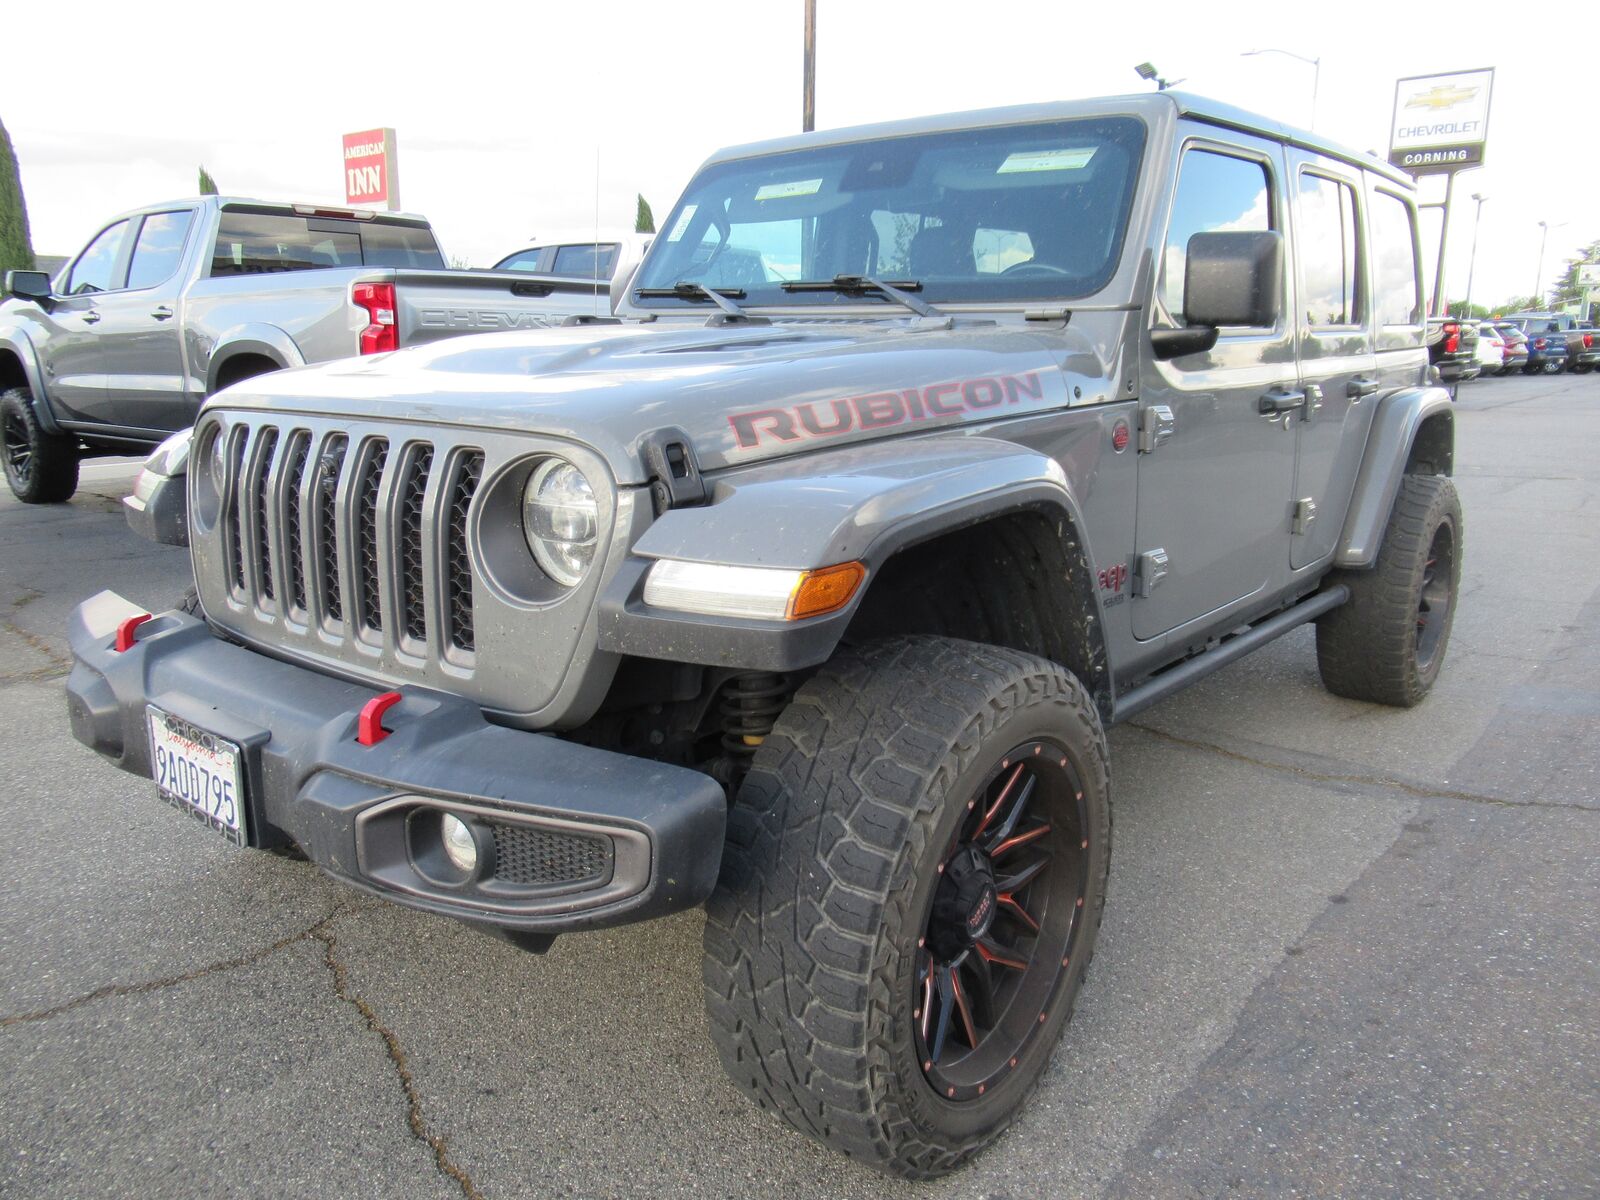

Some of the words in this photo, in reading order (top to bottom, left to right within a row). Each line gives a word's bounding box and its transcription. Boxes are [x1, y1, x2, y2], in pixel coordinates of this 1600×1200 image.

[1398, 120, 1480, 138] CHEVROLET
[345, 141, 385, 159] AMERICAN
[1404, 149, 1467, 165] CORNING
[348, 164, 381, 197] INN
[728, 373, 1044, 450] RUBICON
[166, 715, 215, 750] CHICO
